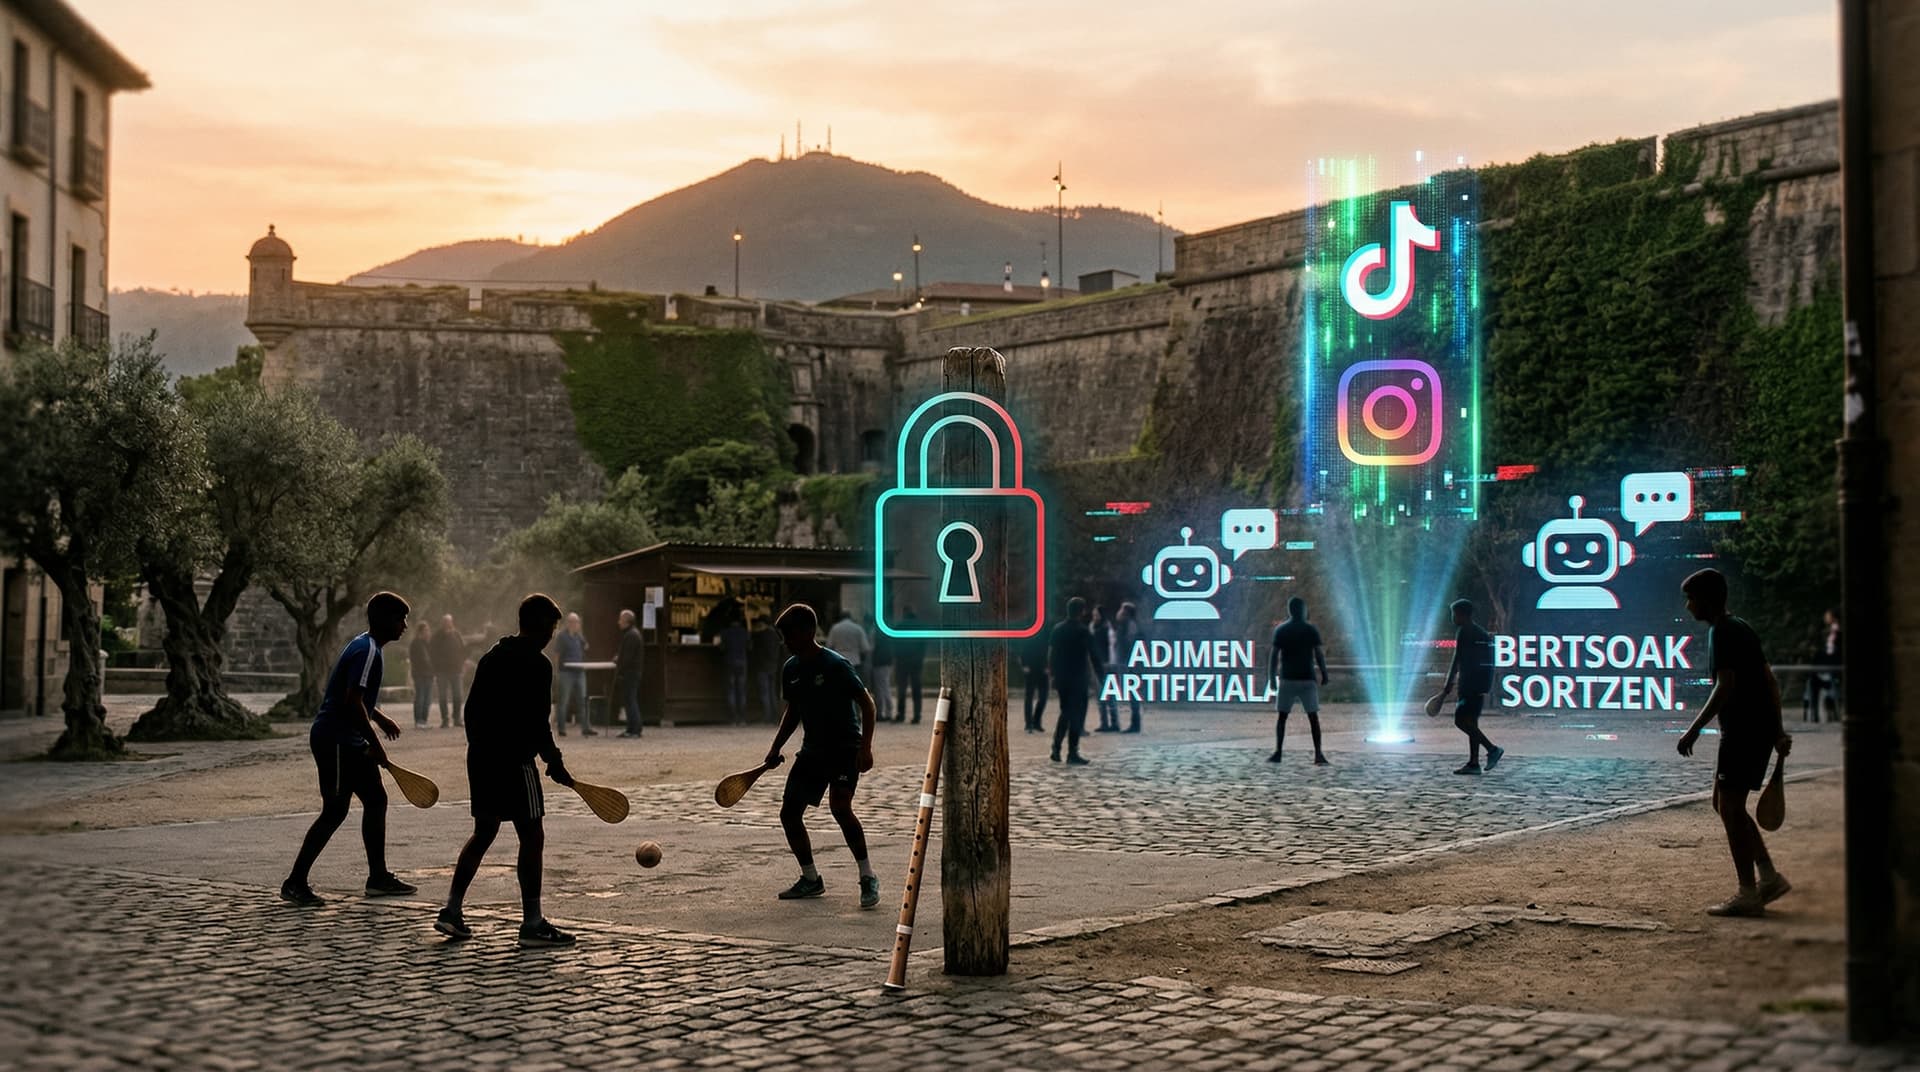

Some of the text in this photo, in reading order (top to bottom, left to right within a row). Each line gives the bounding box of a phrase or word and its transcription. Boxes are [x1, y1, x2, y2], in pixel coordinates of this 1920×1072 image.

[1127, 640, 1255, 668] ADIMEN
[1494, 634, 1692, 669] BERTSOAK
[1501, 674, 1688, 711] SORTZEN.
